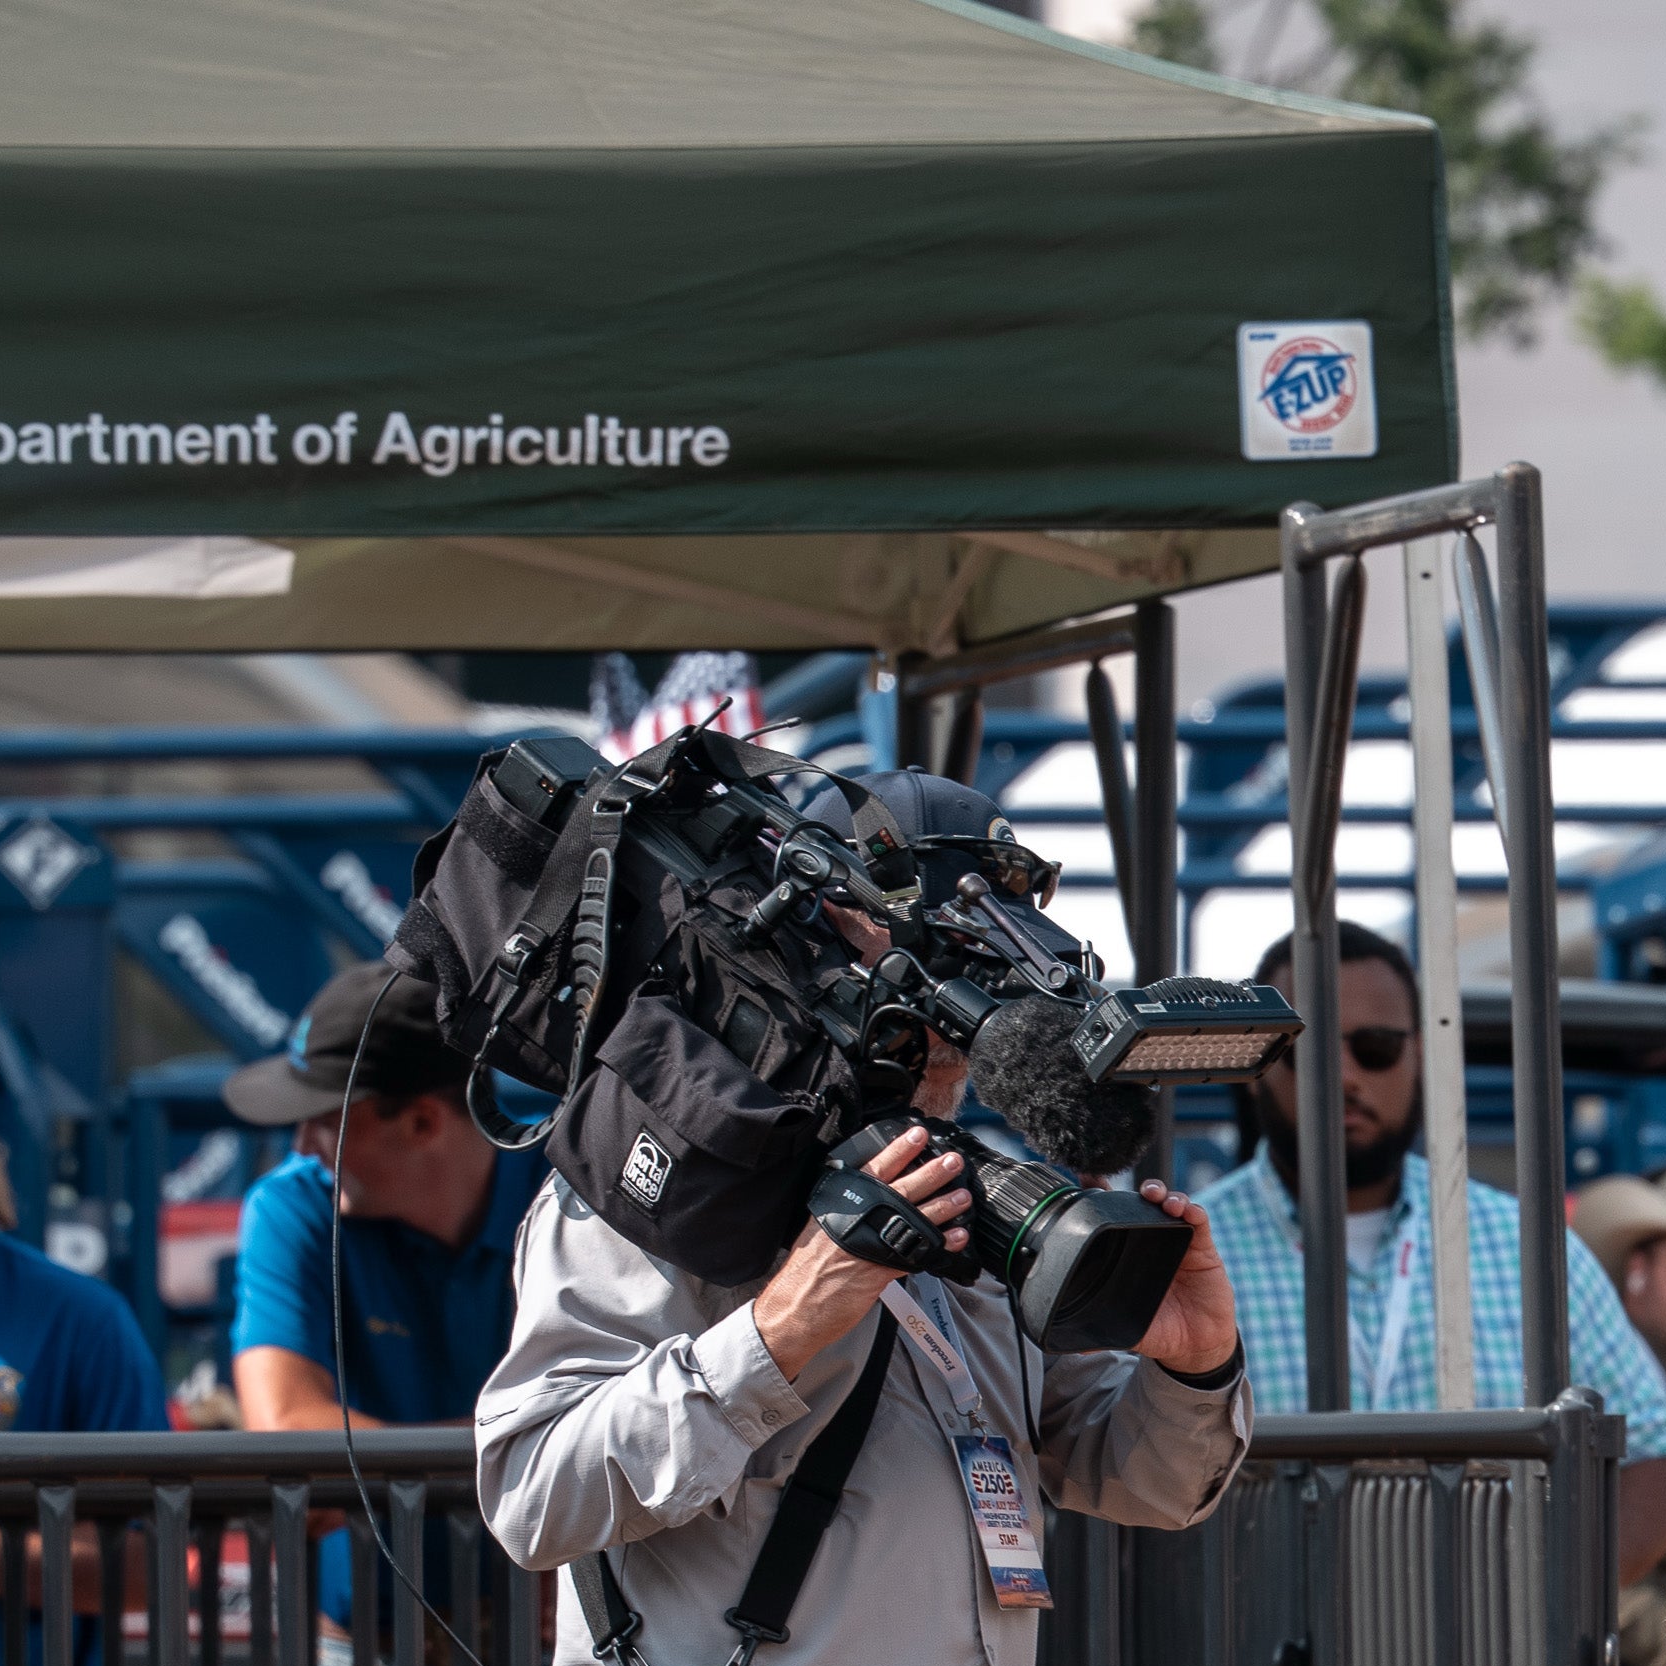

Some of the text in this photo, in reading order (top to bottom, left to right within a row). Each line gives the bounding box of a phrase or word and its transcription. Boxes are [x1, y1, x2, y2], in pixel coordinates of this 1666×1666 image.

[292, 411, 358, 465] of
[373, 410, 731, 477] Agriculture
[626, 1161, 658, 1198] brace
[633, 1148, 664, 1185] porta
[906, 1314, 955, 1372] Freedom 250
[972, 1460, 1007, 1474] AMERICA
[980, 1473, 1006, 1495] 250
[998, 1534, 1019, 1546] STAFF
